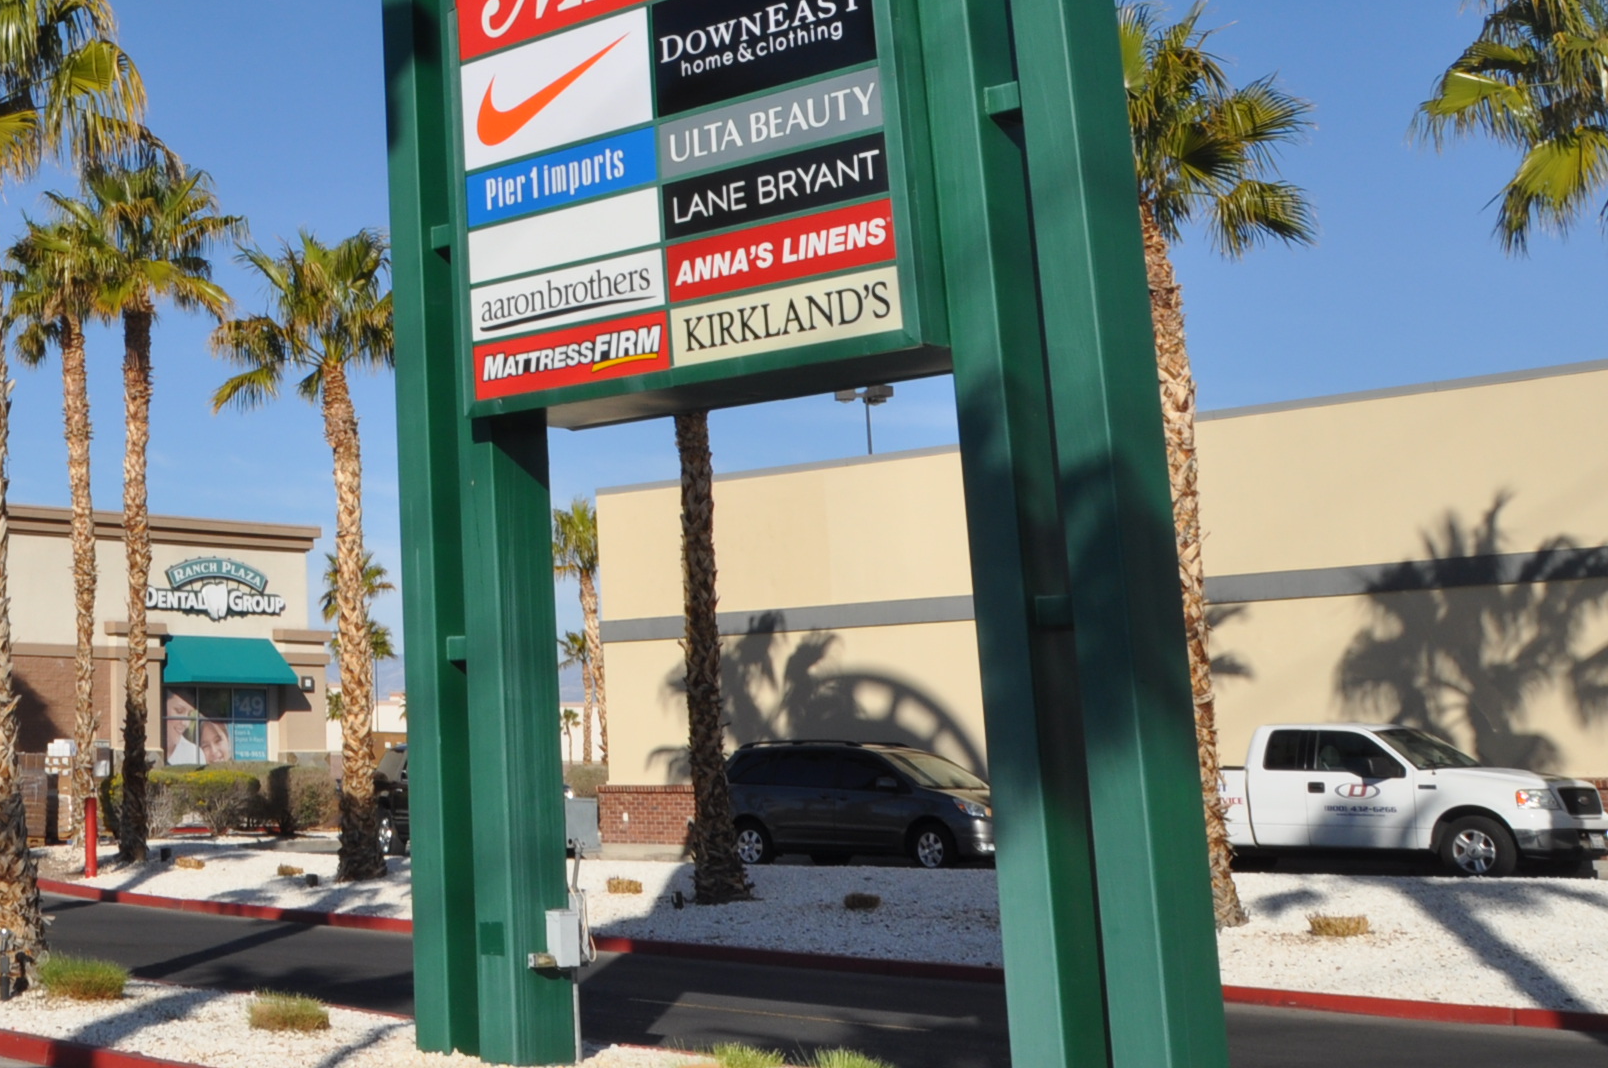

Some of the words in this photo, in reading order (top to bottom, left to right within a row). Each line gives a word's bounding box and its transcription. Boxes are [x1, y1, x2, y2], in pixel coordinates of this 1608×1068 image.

[669, 118, 743, 163] ULTA
[749, 82, 875, 144] BEAUTY
[485, 172, 526, 211] Pier
[530, 165, 539, 200] 1
[543, 148, 625, 196] imports
[673, 180, 747, 224] LANE
[757, 149, 880, 205] BRYANT
[675, 242, 774, 286] ANNA'S
[683, 281, 891, 353] KIRKLAND'S
[145, 587, 208, 610] DENTAL
[229, 590, 286, 614] GROUP
[173, 562, 217, 582] RANCH
[221, 561, 261, 587] PLAZA
[1324, 804, 1348, 812] (800)
